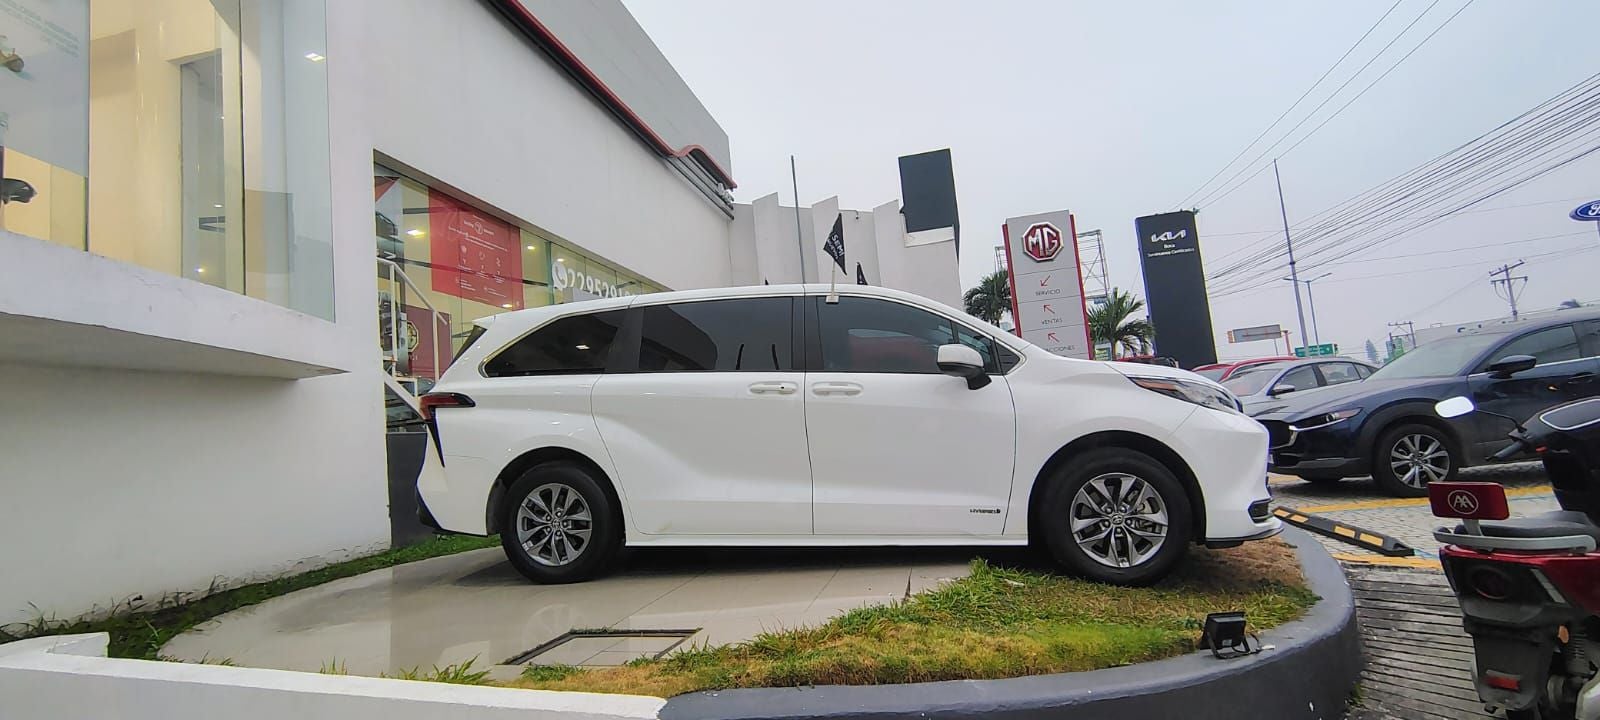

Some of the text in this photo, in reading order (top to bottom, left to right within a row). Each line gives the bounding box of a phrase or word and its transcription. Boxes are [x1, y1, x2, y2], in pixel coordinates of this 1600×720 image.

[1151, 229, 1186, 242] KIA
[1028, 227, 1059, 258] MG
[1045, 345, 1076, 353] ACCIONES
